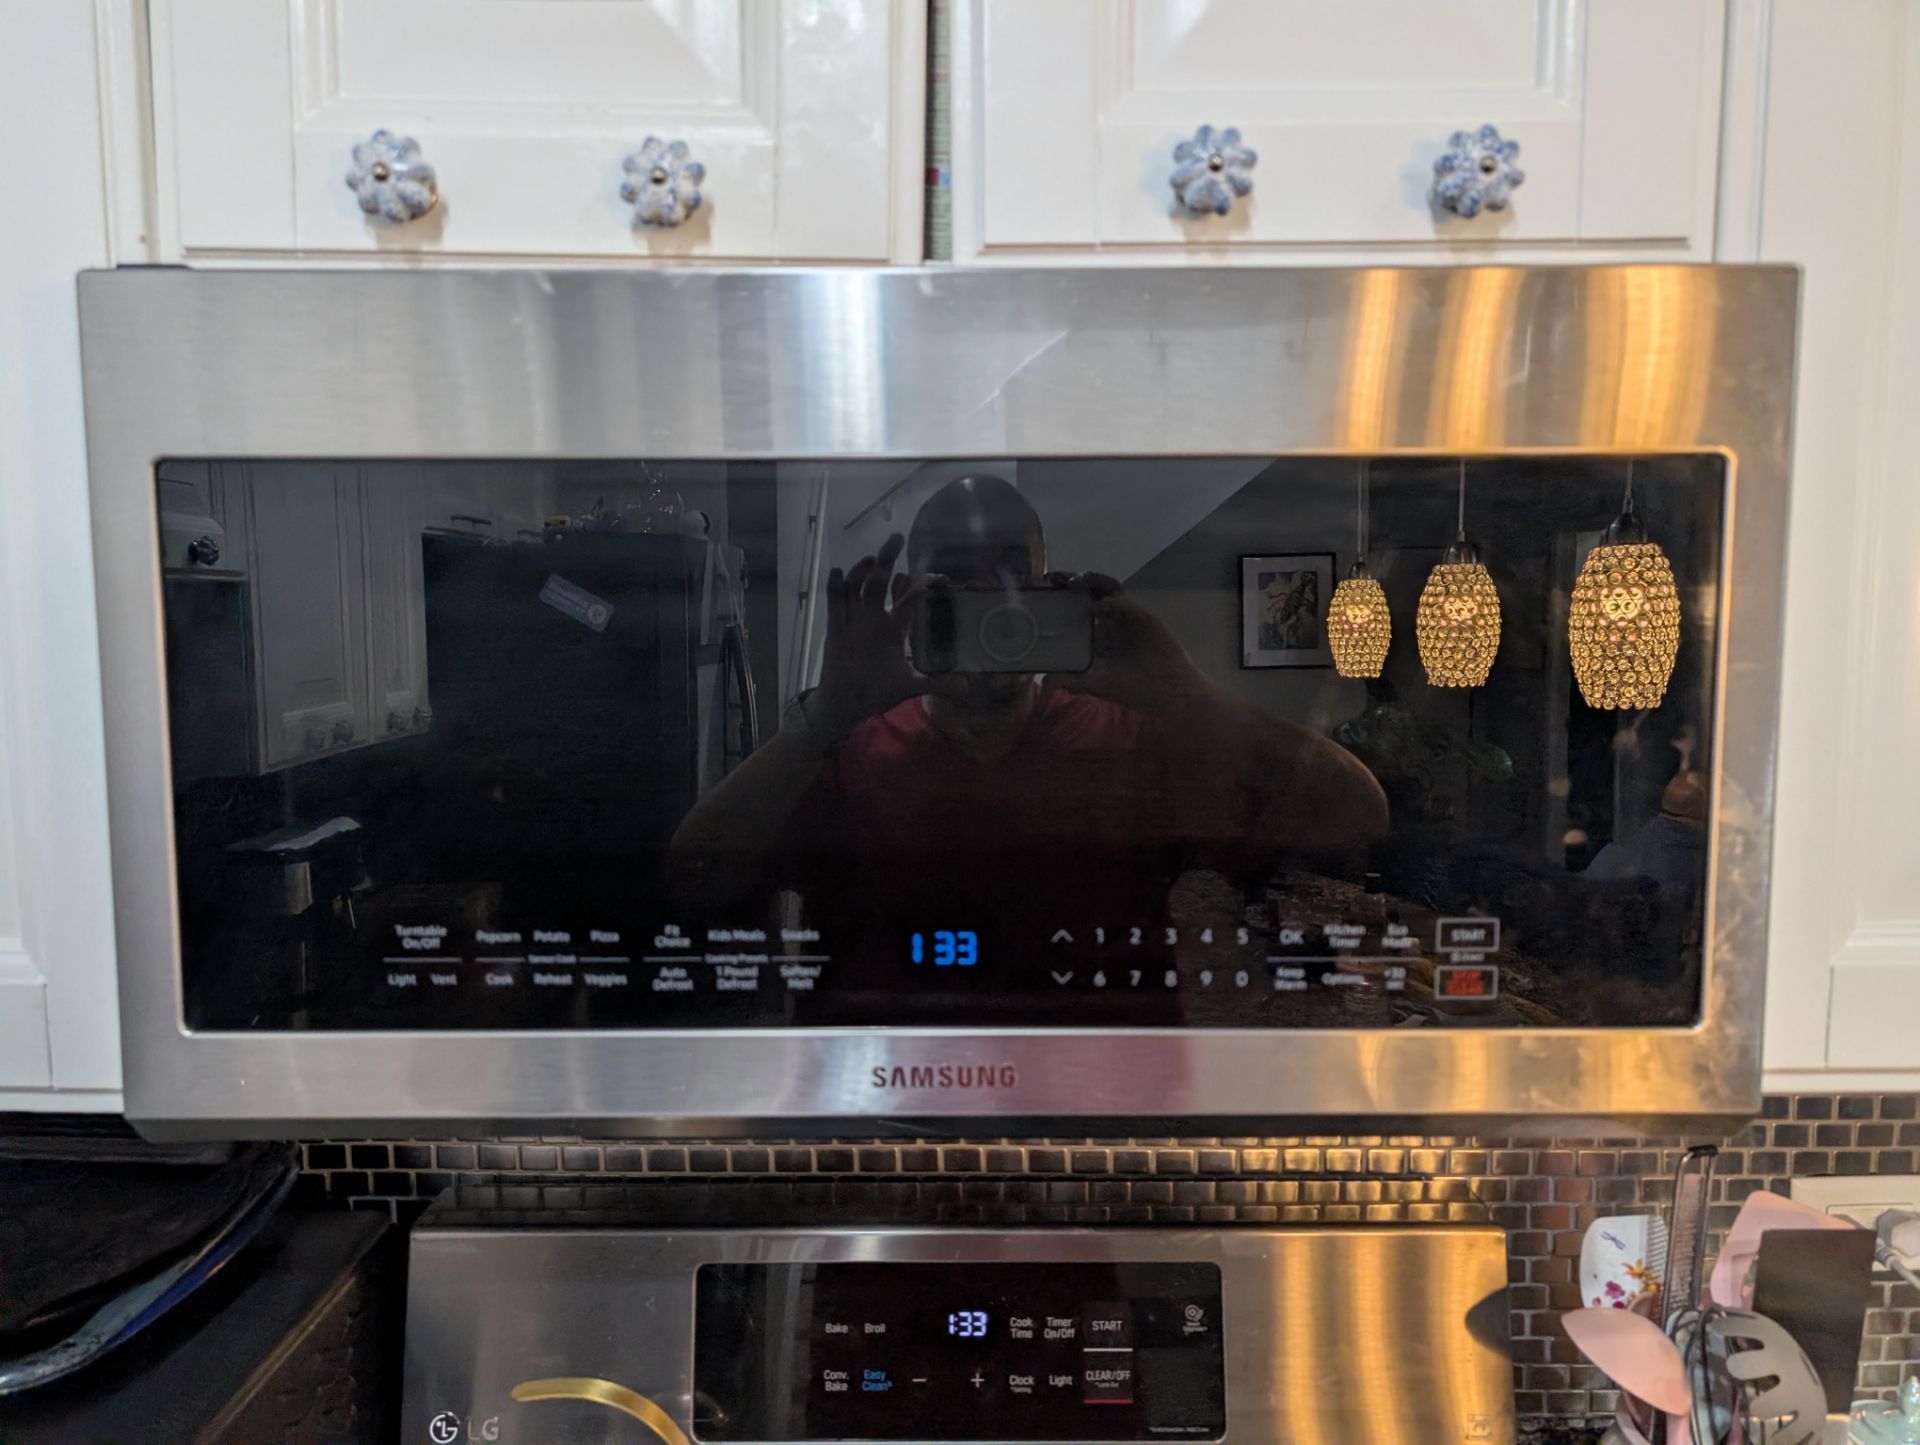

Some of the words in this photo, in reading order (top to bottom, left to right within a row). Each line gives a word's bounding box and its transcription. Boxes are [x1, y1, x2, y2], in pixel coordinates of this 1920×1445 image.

[395, 924, 448, 937] Turntable
[533, 930, 571, 943] Potato
[1095, 928, 1104, 944] 1
[1129, 928, 1142, 944] 2
[1165, 928, 1177, 945] 3
[1200, 928, 1213, 944] 4
[1236, 928, 1249, 945] 5
[1279, 929, 1303, 944] OK
[402, 937, 441, 950] On/Off
[476, 930, 522, 945] Popcorn
[659, 966, 687, 978] Auto
[1094, 970, 1106, 987] 6
[1129, 970, 1142, 986] 7
[1165, 970, 1177, 987] 8
[1200, 970, 1213, 986] 9
[1235, 970, 1248, 987] 0
[388, 973, 417, 988] Light
[430, 973, 458, 986] Vent
[485, 973, 514, 986] Cook
[533, 973, 573, 986] Reheat
[872, 1065, 1016, 1088] SAMSUNG
[825, 1322, 849, 1334] Bake
[864, 1322, 886, 1334] Broil
[1009, 1316, 1033, 1327] Cook
[1045, 1316, 1072, 1327] Timer
[1091, 1320, 1123, 1331] START
[1011, 1328, 1033, 1339] Time
[1043, 1328, 1076, 1339] On/Off
[823, 1369, 850, 1380] Conv.
[863, 1369, 887, 1381] Easy
[1008, 1374, 1035, 1386] Clock
[1048, 1374, 1073, 1388] Light
[1085, 1370, 1131, 1381] CLEAR/OFF
[824, 1380, 849, 1392] Bake
[467, 1416, 499, 1441] LG
